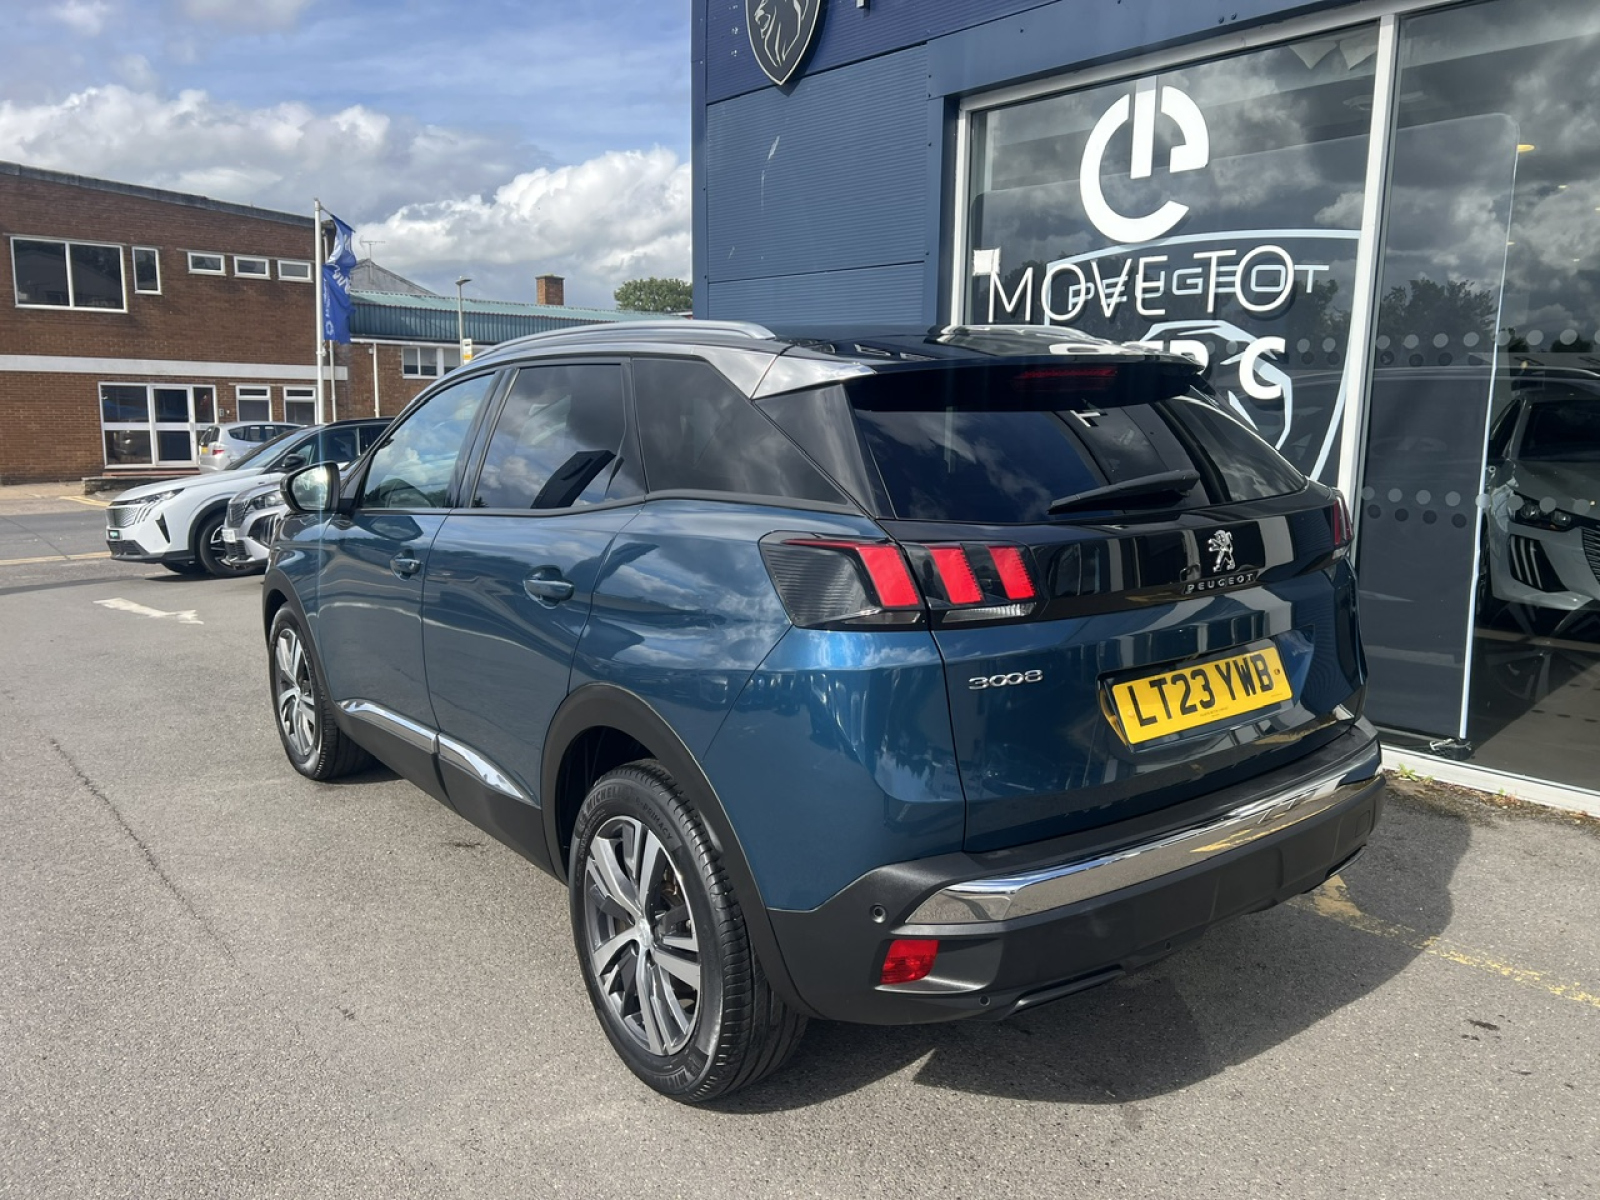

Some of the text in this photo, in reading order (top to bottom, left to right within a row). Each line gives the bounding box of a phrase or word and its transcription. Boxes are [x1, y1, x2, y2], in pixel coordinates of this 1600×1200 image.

[988, 244, 1295, 324] MOVE TO
[1067, 264, 1330, 312] PEUGEOT
[1184, 573, 1254, 595] PEUGEOT
[968, 669, 1044, 690] 3008
[1127, 653, 1275, 727] LT23 YWB
